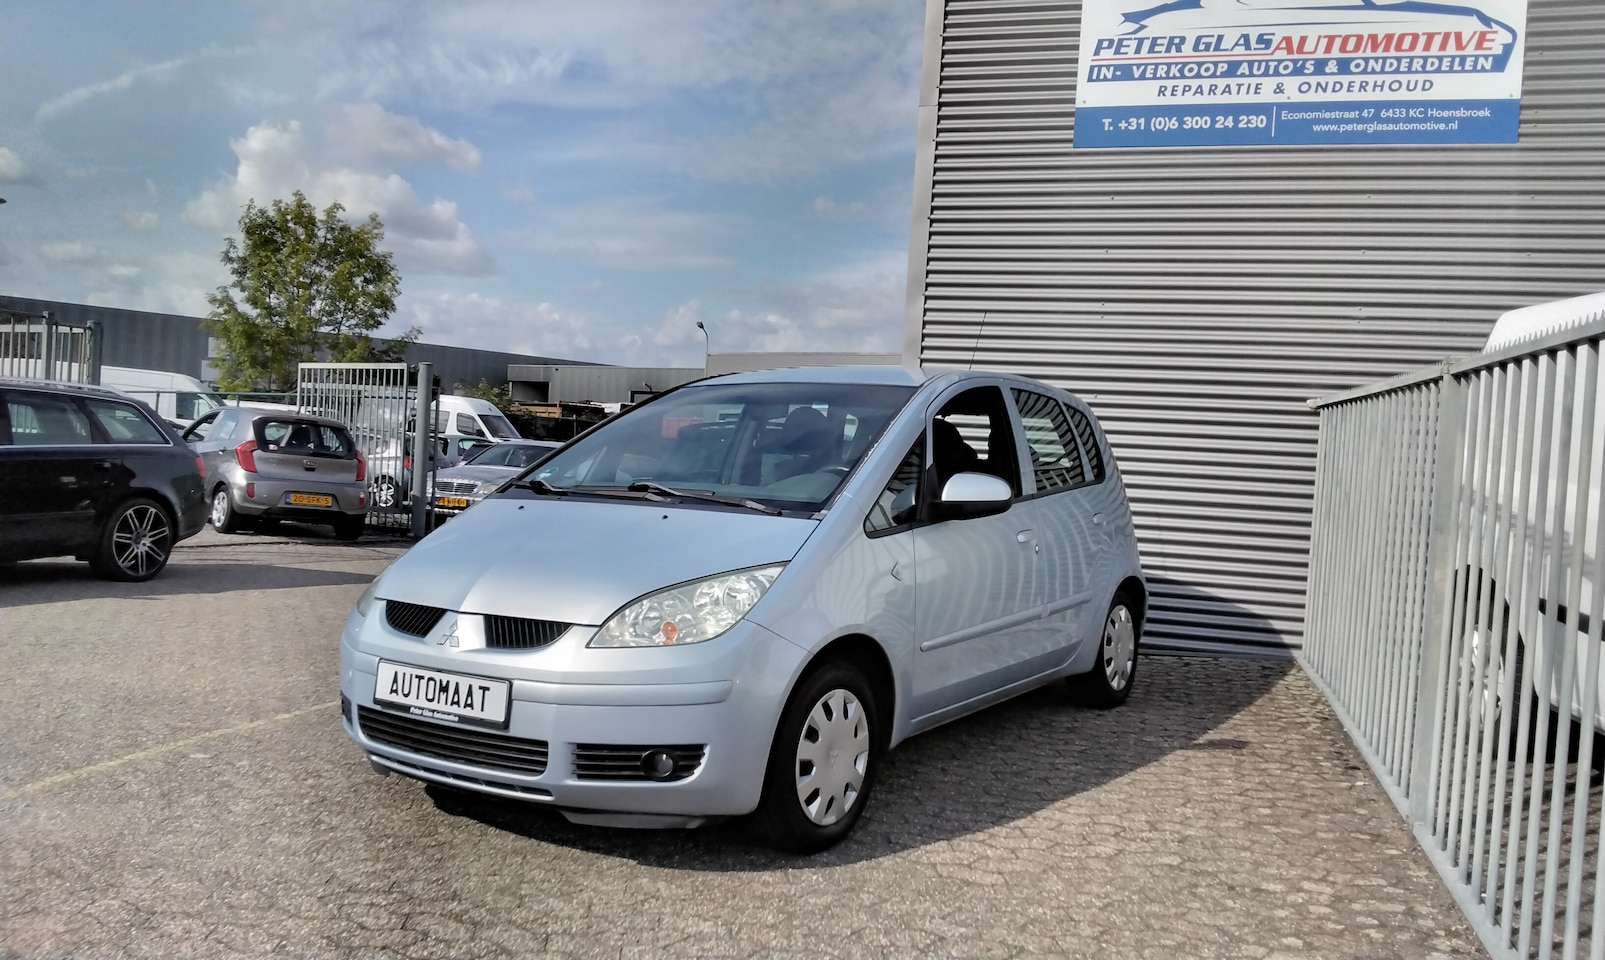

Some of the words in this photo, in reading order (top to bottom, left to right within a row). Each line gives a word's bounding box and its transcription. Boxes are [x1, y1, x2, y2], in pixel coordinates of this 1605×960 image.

[1092, 34, 1187, 56] PETER
[1091, 66, 1122, 80] IN-
[1132, 62, 1228, 79] VERKOOP
[1236, 58, 1315, 76] AUTO'S
[1325, 59, 1338, 74] &
[1350, 56, 1493, 73] ONDERDELEN
[1157, 83, 1263, 98] REPARATIE
[1273, 82, 1285, 95] &
[1297, 79, 1434, 95] ONDERHOUD
[1281, 109, 1359, 120] Economiestraat
[1362, 108, 1375, 119] 47
[1380, 108, 1406, 118] 6433
[1409, 107, 1424, 118] KC
[1427, 106, 1491, 118] Hoensbroek
[1102, 118, 1114, 131] T.
[1118, 117, 1146, 131] +31
[1150, 116, 1179, 132] (0)6
[1183, 115, 1213, 129] 300
[1215, 115, 1234, 129] 24
[1238, 114, 1267, 129] 230
[1312, 121, 1458, 133] www.peterglasautomotive.nl
[389, 670, 490, 712] AUTOMAAT
